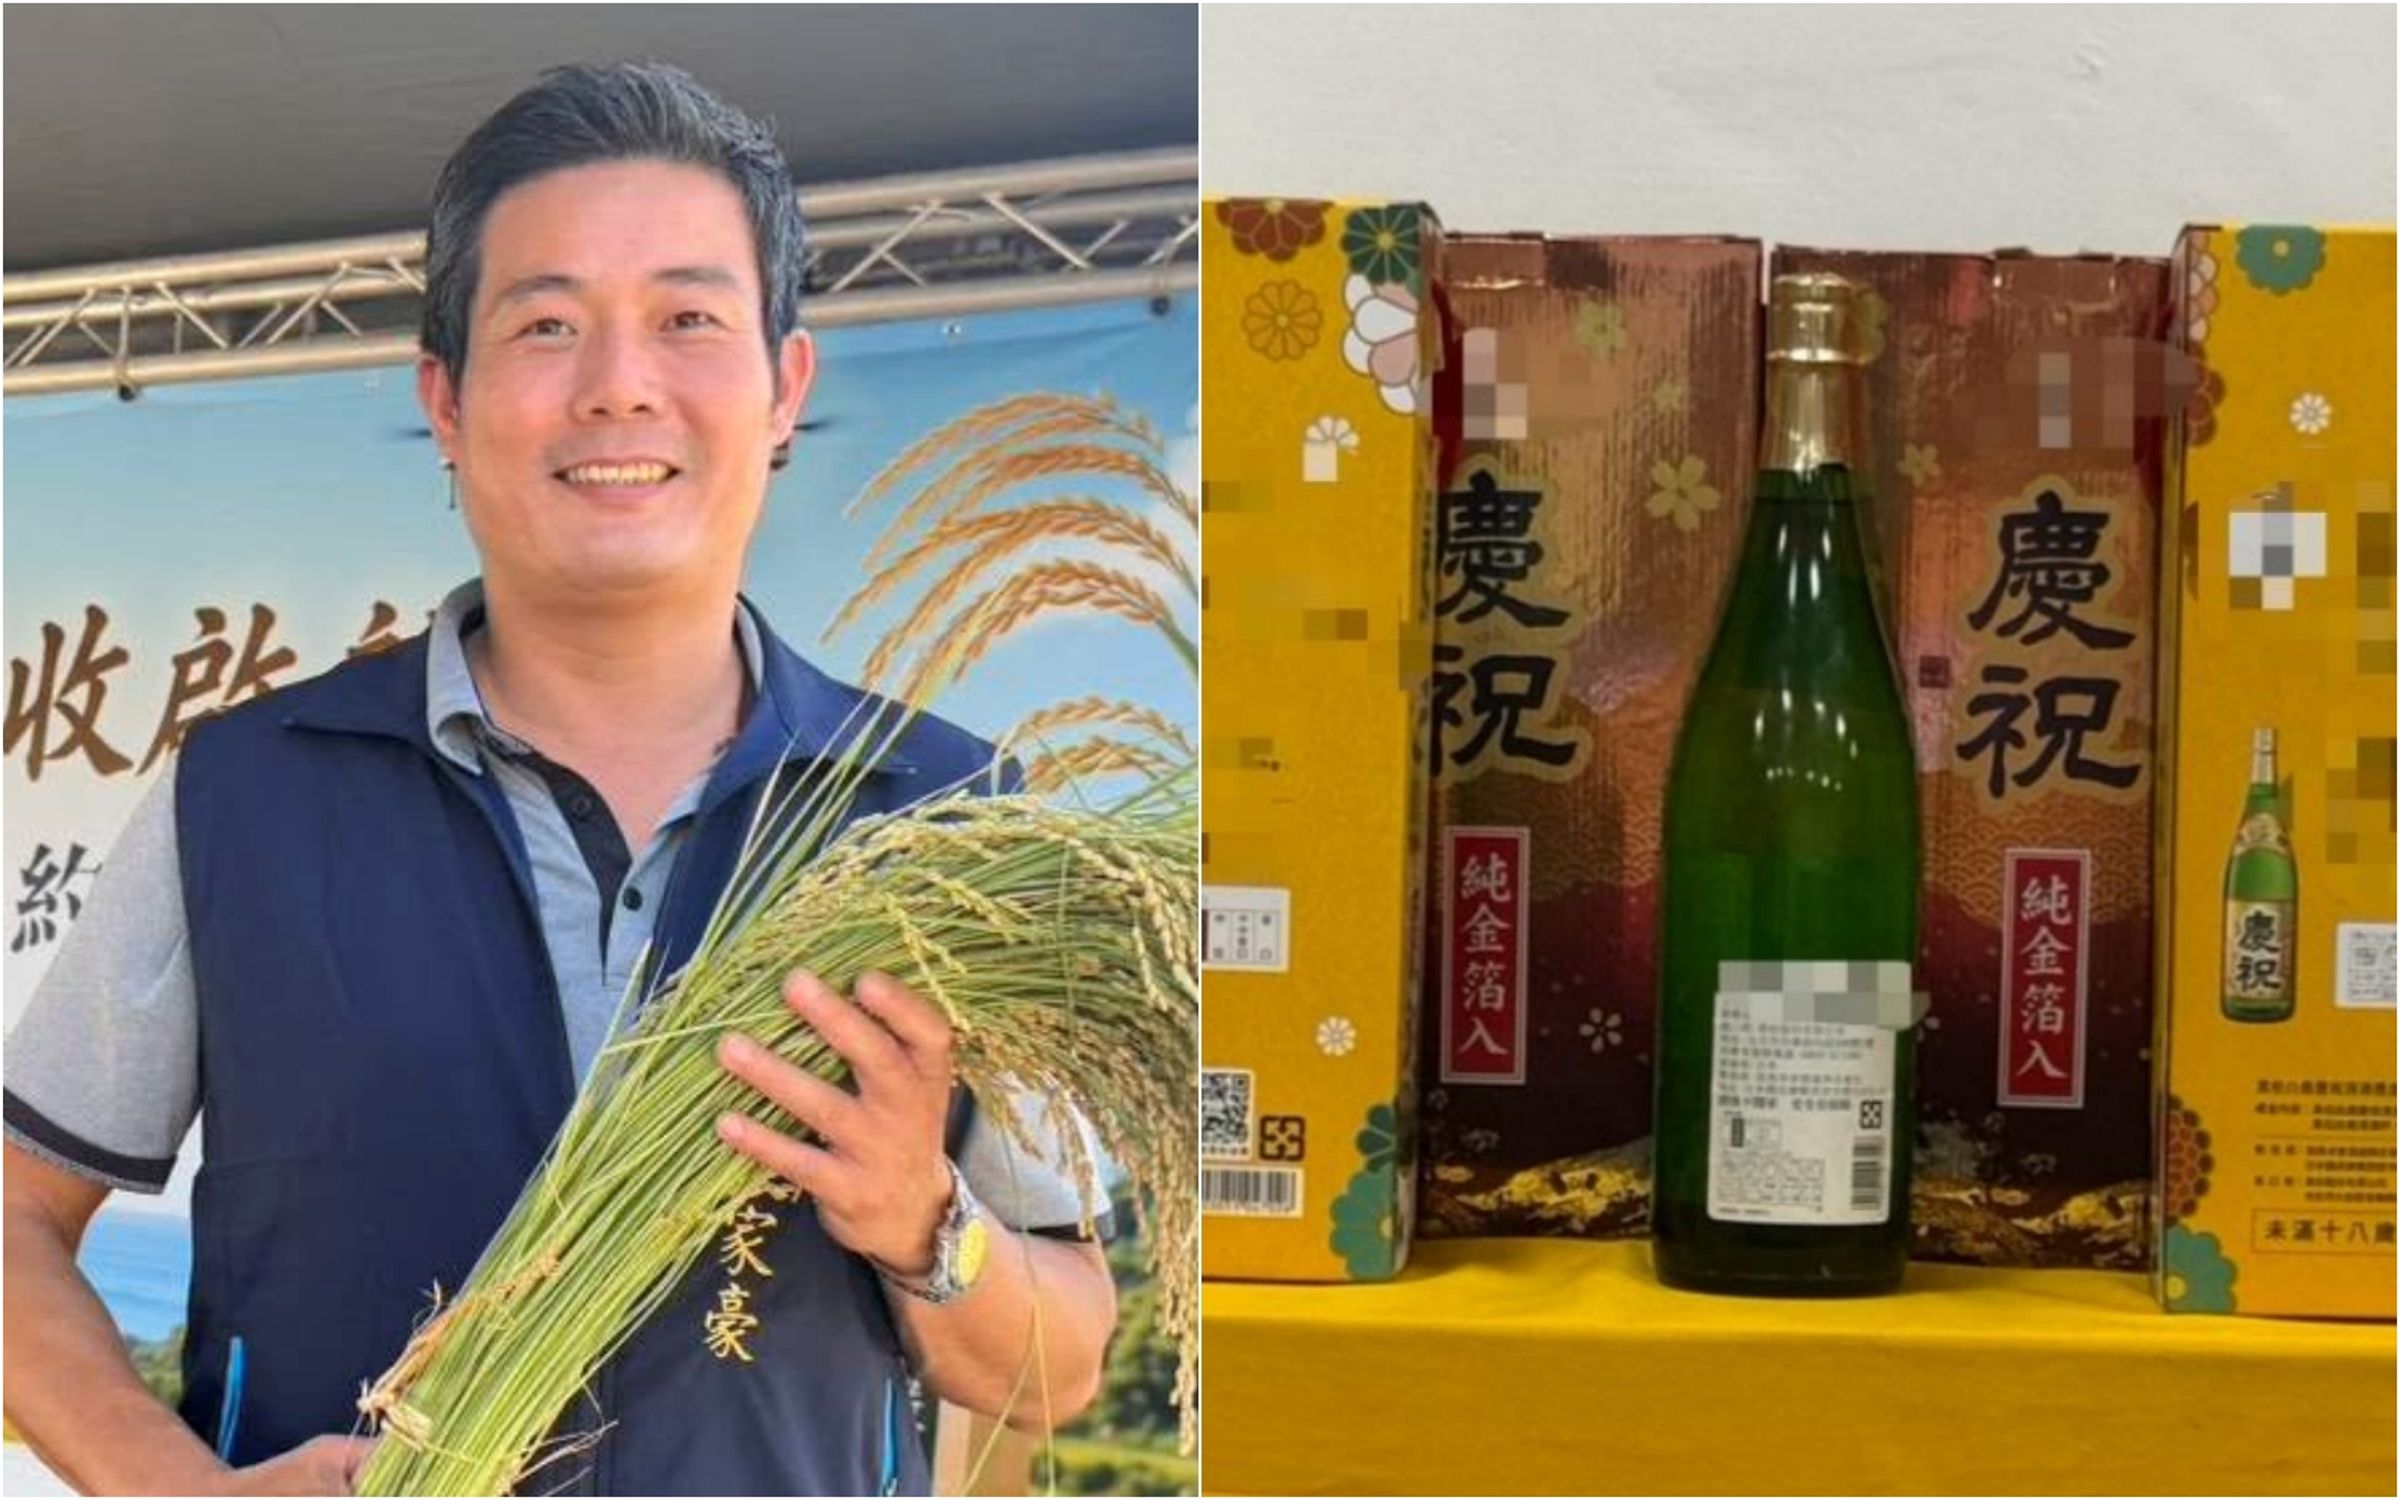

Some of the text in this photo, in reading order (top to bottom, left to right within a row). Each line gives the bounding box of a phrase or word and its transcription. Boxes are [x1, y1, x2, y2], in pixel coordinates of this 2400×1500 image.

[3, 602, 437, 780] 收啟
[1430, 468, 1578, 778] 慶祝
[1956, 489, 2142, 799] 慶祝
[1459, 851, 1511, 1056] 純金箔入
[2016, 875, 2073, 1079] 純金箔入
[2236, 910, 2282, 990] 慶祝
